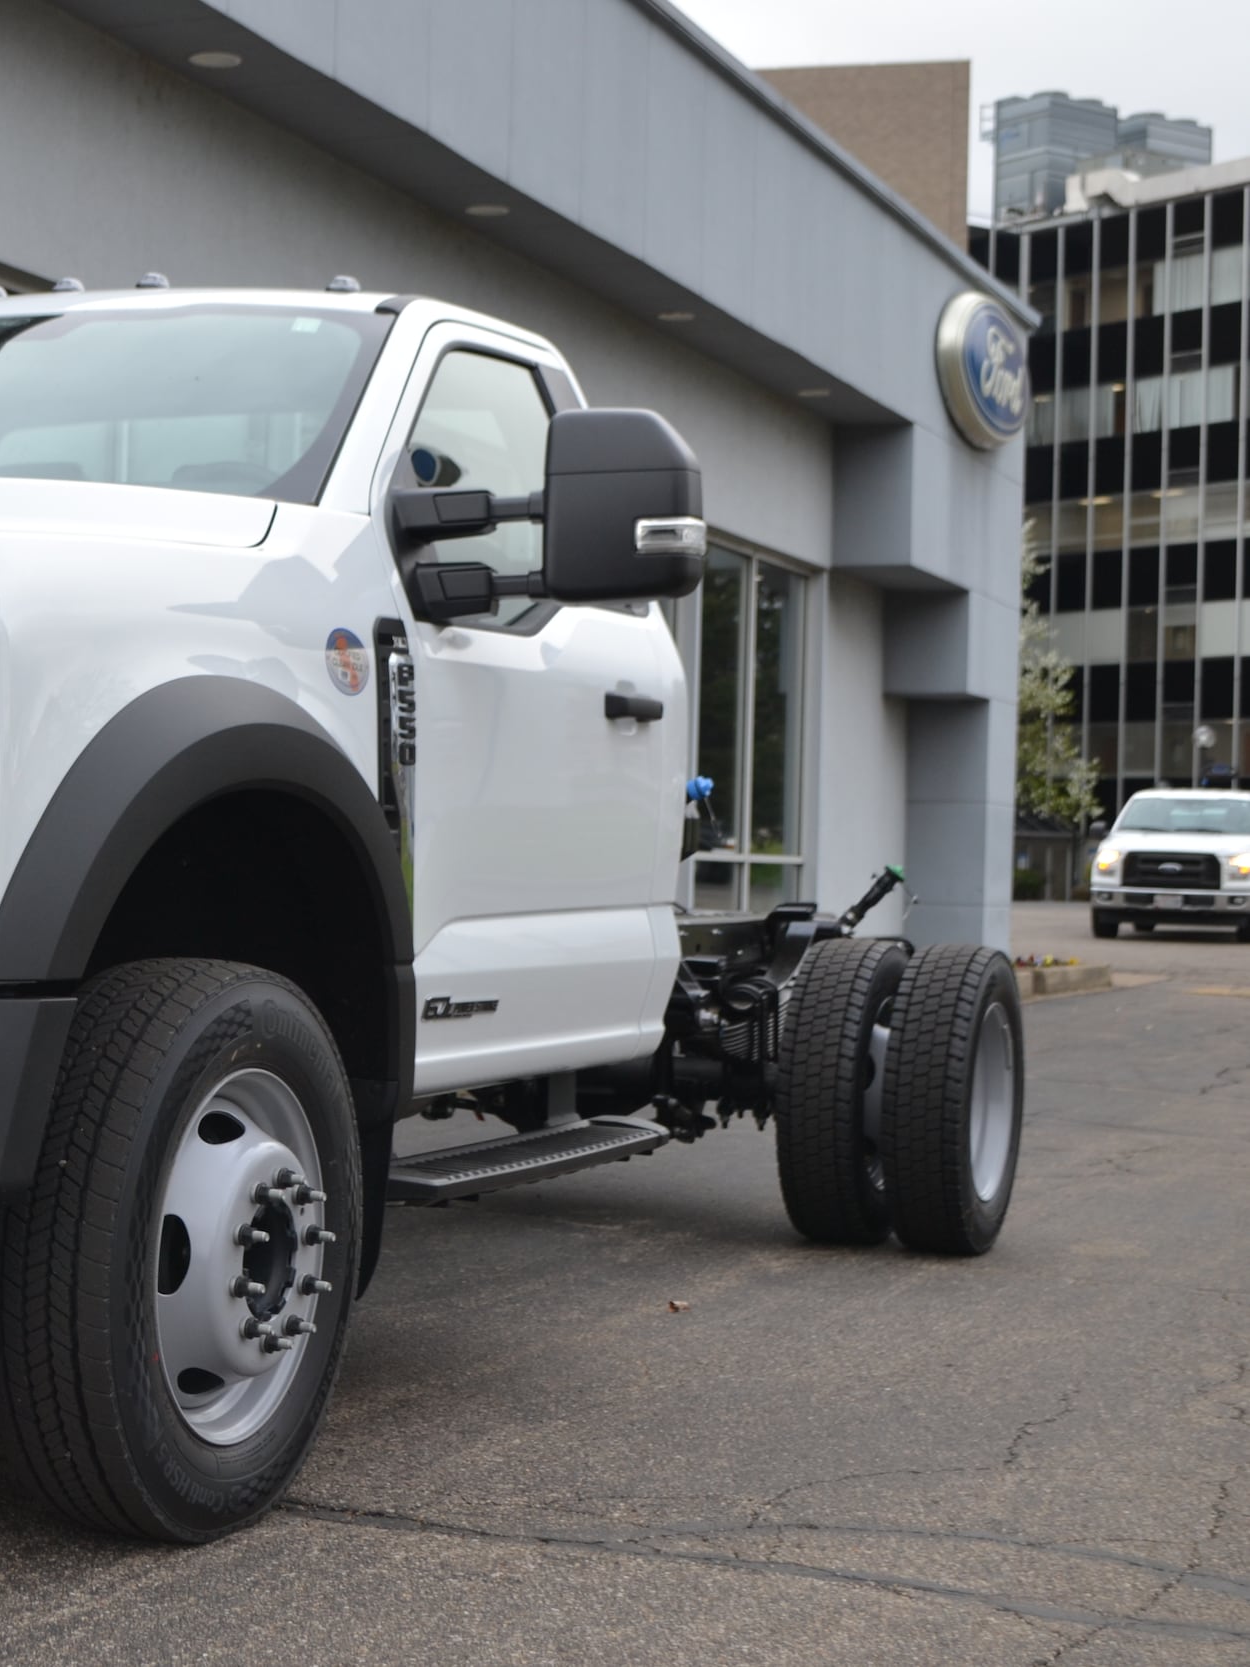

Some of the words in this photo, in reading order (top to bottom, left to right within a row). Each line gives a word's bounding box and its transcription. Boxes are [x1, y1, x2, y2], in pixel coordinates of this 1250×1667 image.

[981, 325, 1023, 415] Ford
[392, 635, 407, 649] XL
[186, 1480, 225, 1514] Conti
